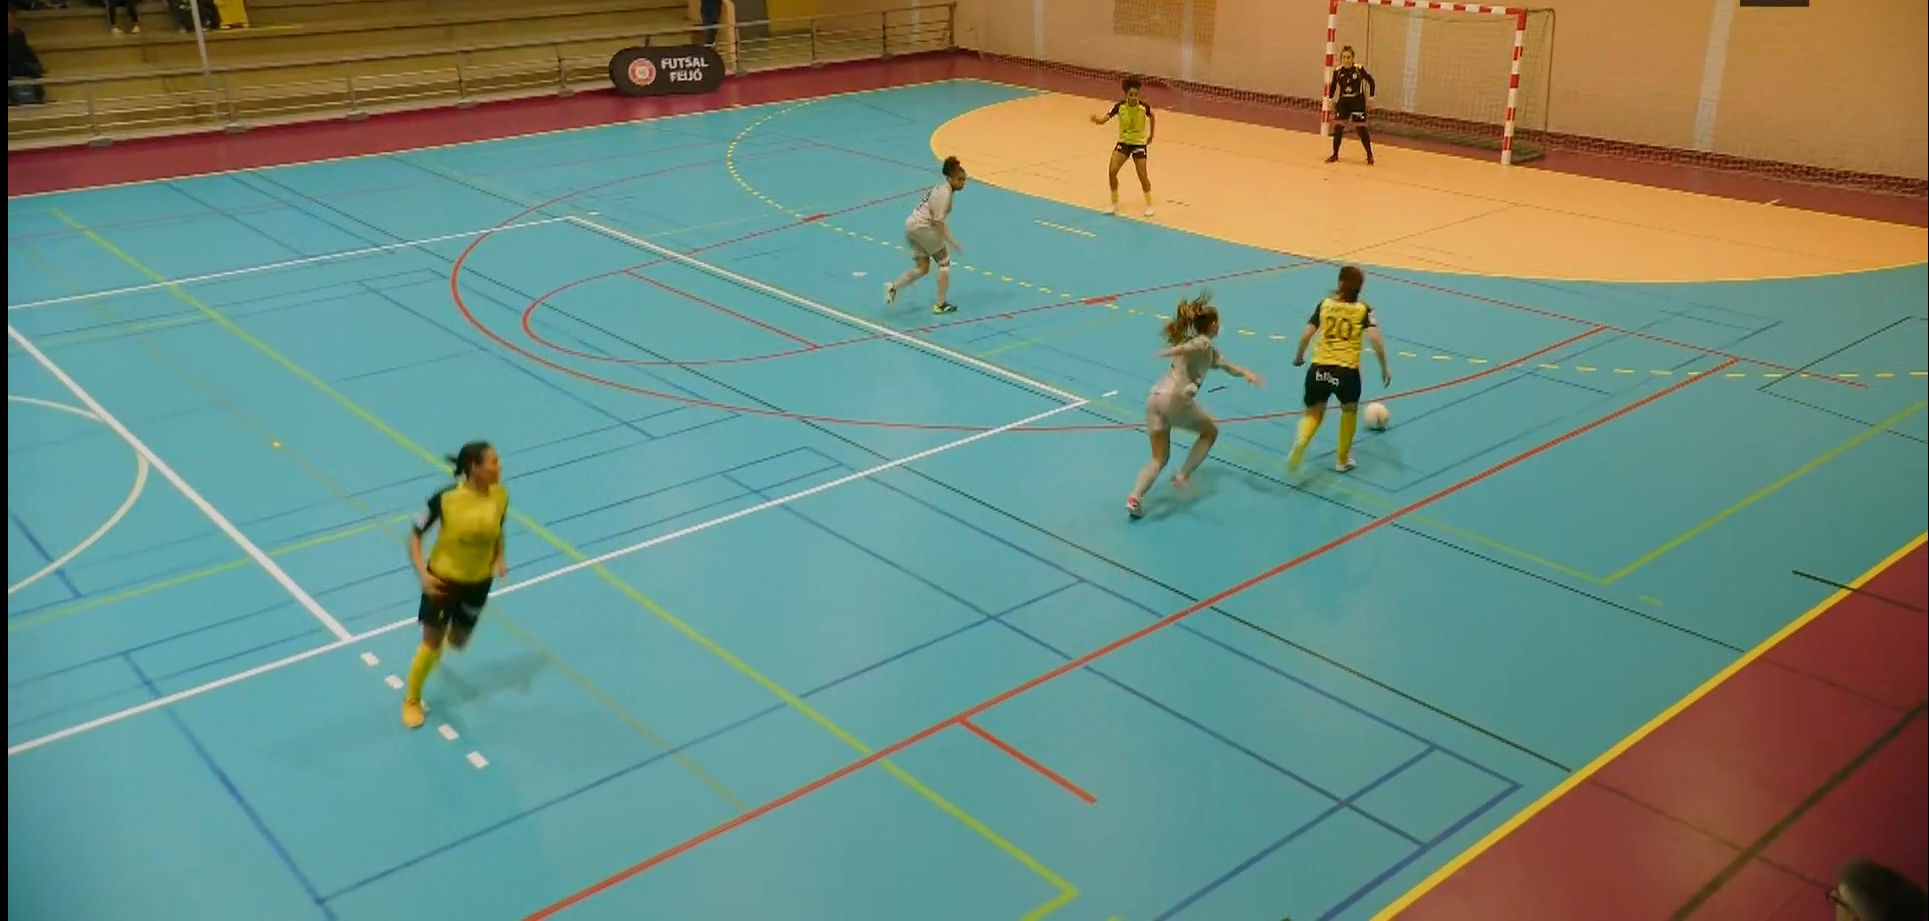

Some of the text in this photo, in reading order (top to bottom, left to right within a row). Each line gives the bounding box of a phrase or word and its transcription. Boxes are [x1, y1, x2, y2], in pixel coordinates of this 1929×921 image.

[661, 56, 709, 70] FUTSAL
[669, 68, 703, 82] FEIJÓ
[1325, 315, 1353, 341] 20
